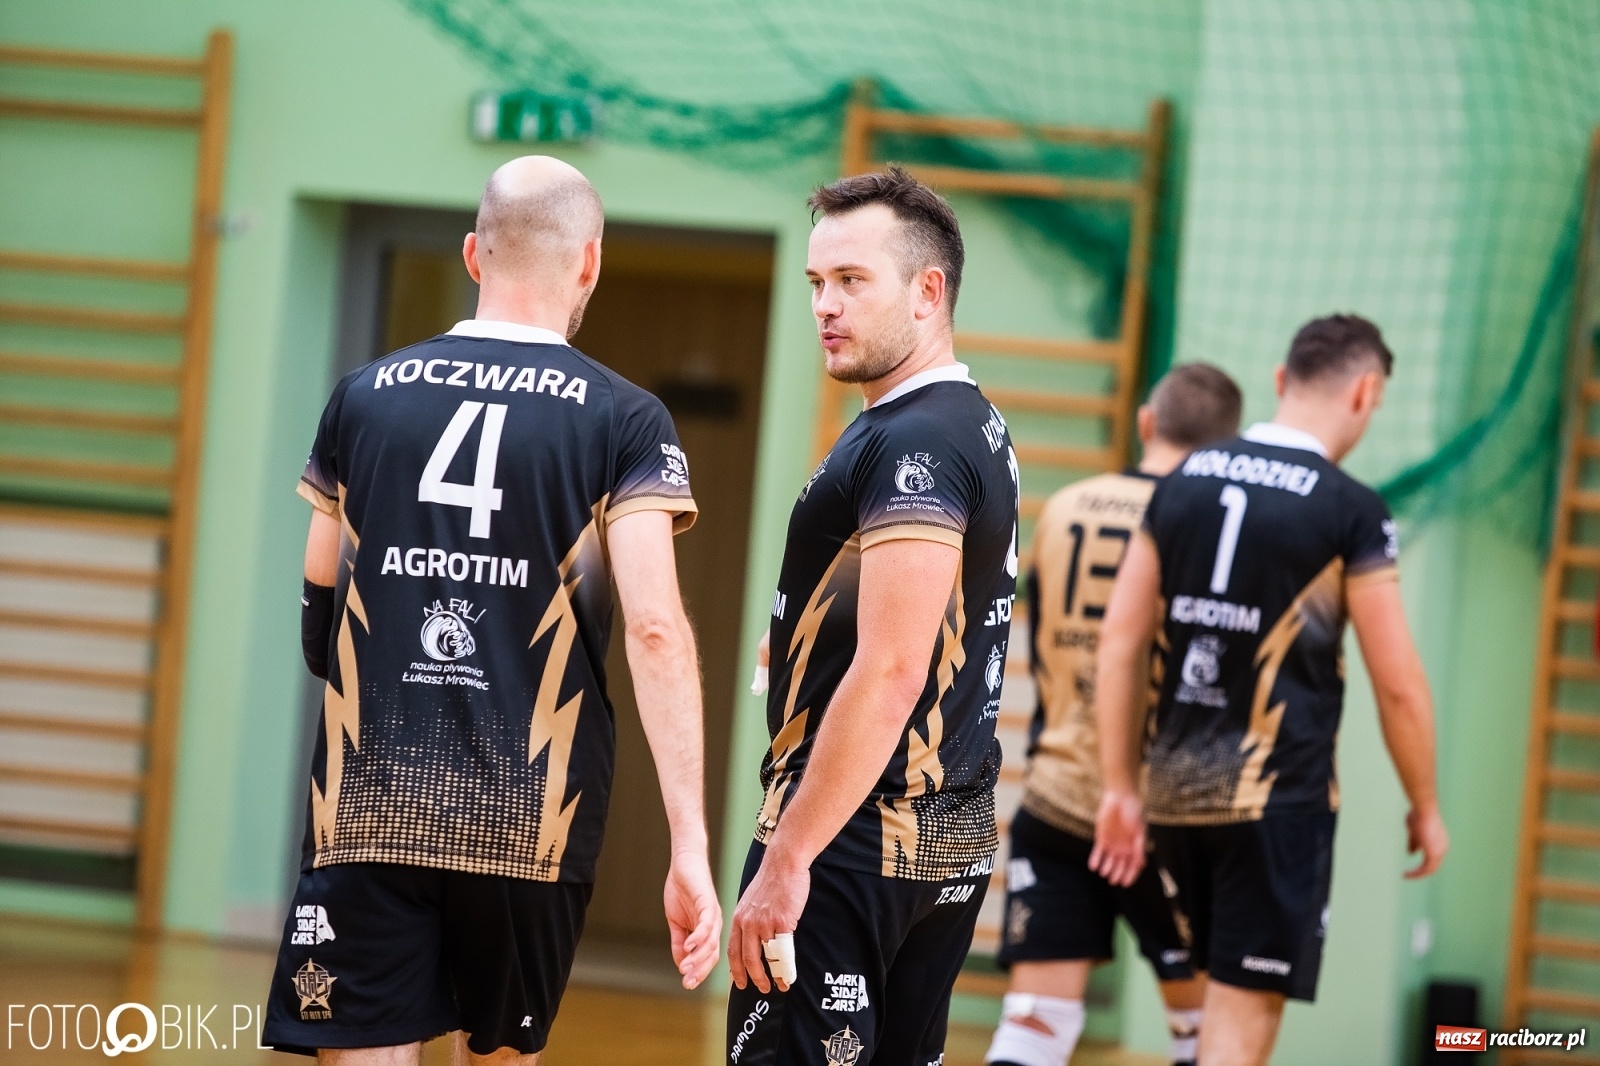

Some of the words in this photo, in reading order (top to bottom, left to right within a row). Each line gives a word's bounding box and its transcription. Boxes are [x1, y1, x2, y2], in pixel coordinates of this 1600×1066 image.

[373, 358, 588, 405] KOCZWARA
[417, 400, 509, 539] 4
[896, 453, 911, 467] NA
[914, 452, 941, 469] FALI
[1182, 448, 1320, 497] KOŁODZIEJ
[886, 503, 912, 512] Łukasz
[912, 502, 945, 513] Mrowiec
[889, 494, 910, 503] nauka
[1210, 484, 1248, 595] 1
[380, 546, 529, 588] AGROTIM
[423, 599, 445, 617] NA
[448, 597, 487, 624] FALI
[409, 661, 442, 672] nauka
[402, 671, 444, 685] Łukasz
[444, 674, 490, 691] Mrowiec
[934, 884, 976, 906] TEAM
[297, 918, 316, 932] SIDE
[290, 931, 315, 946] CARS
[296, 970, 329, 1000] GAS
[824, 971, 858, 987] DARK
[830, 985, 858, 1000] SIDE
[821, 997, 856, 1012] CARS
